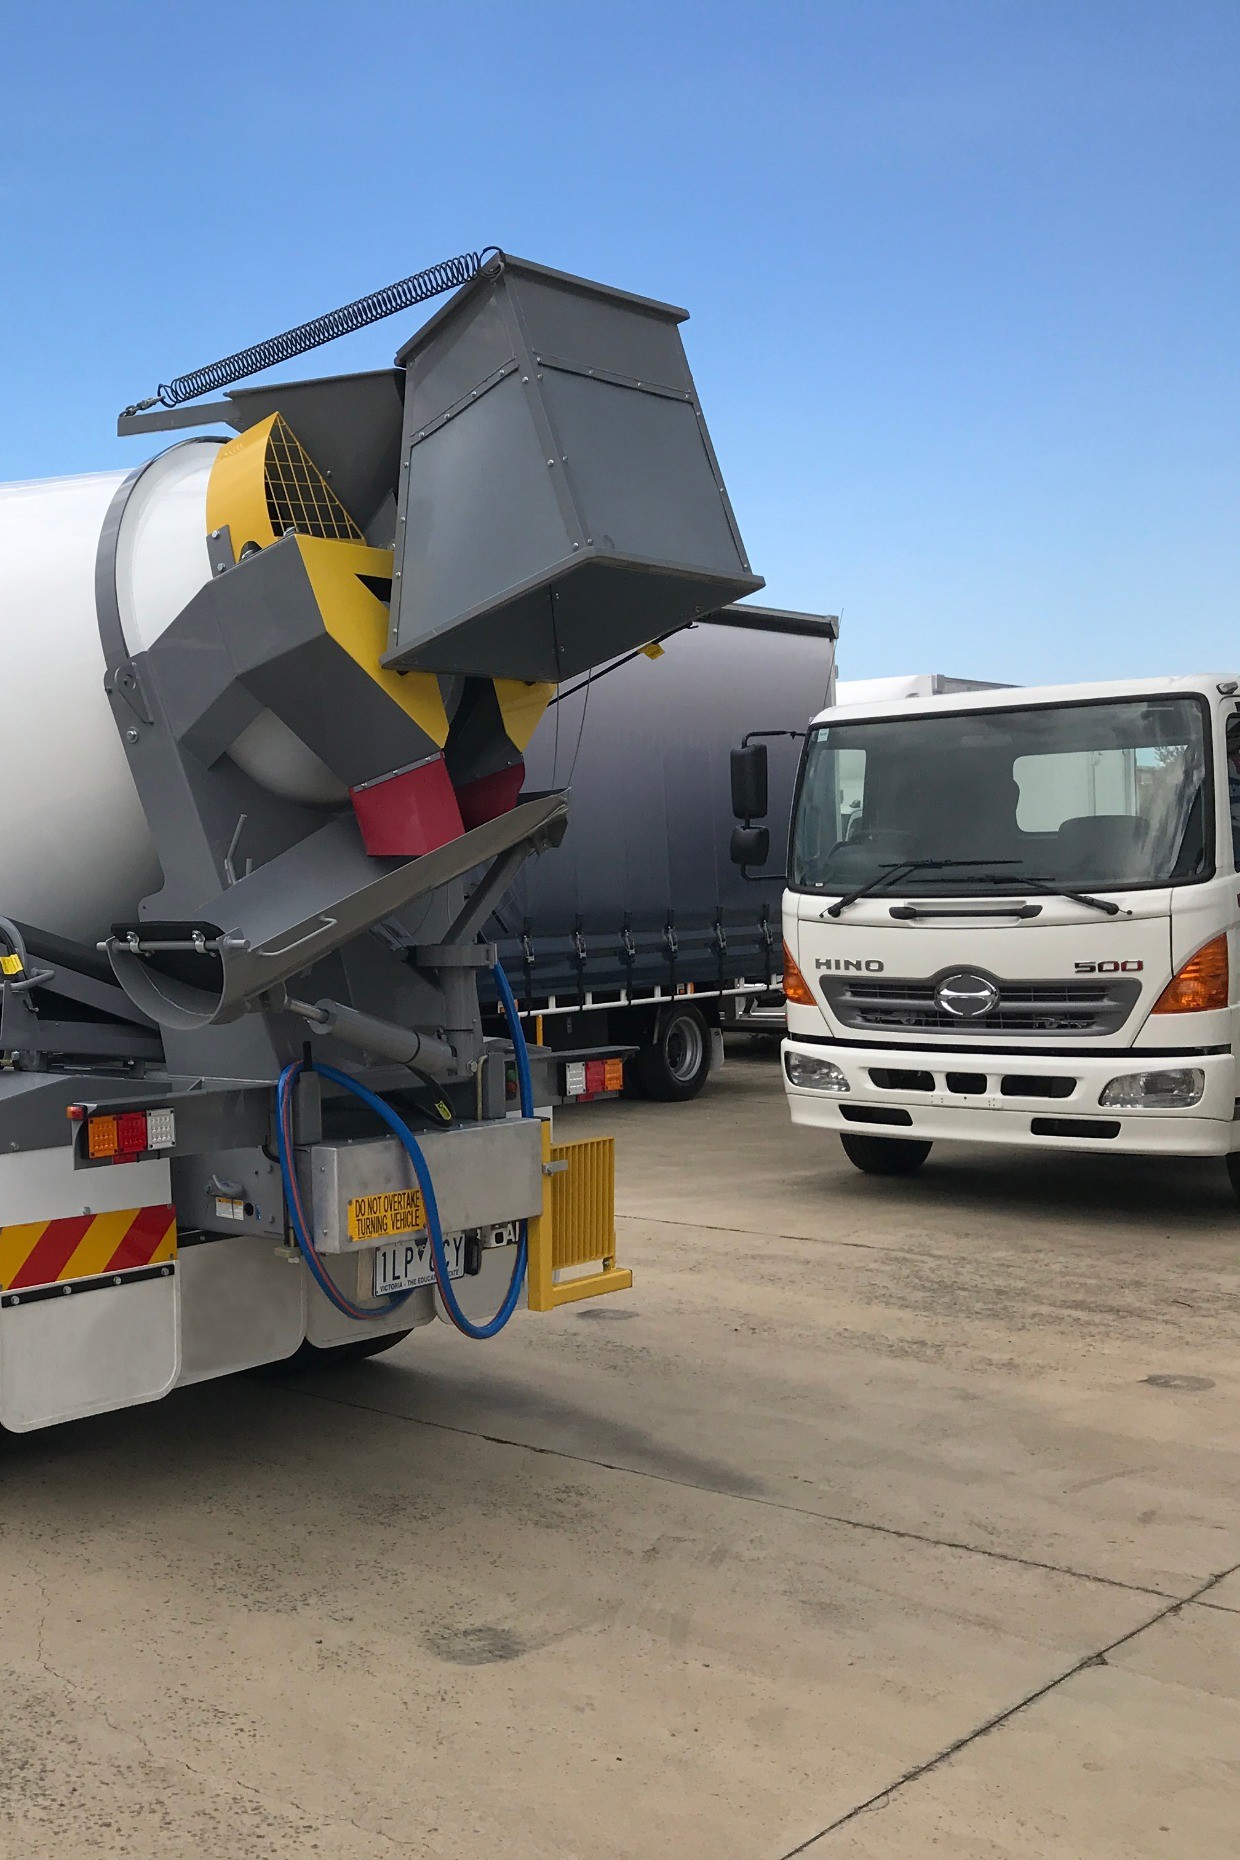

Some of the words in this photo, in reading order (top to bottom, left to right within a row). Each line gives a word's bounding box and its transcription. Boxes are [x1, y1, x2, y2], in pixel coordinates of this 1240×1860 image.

[815, 958, 884, 973] HINO
[1074, 960, 1144, 973] 500
[355, 1199, 366, 1218] DO
[367, 1196, 382, 1215] NOT
[384, 1190, 420, 1212] OVERTAKE
[357, 1215, 388, 1237] TURNING
[391, 1209, 420, 1230] VEHICLE
[382, 1247, 413, 1282] 1LP
[380, 1283, 403, 1293] VICTORIA
[407, 1277, 417, 1286] THE
